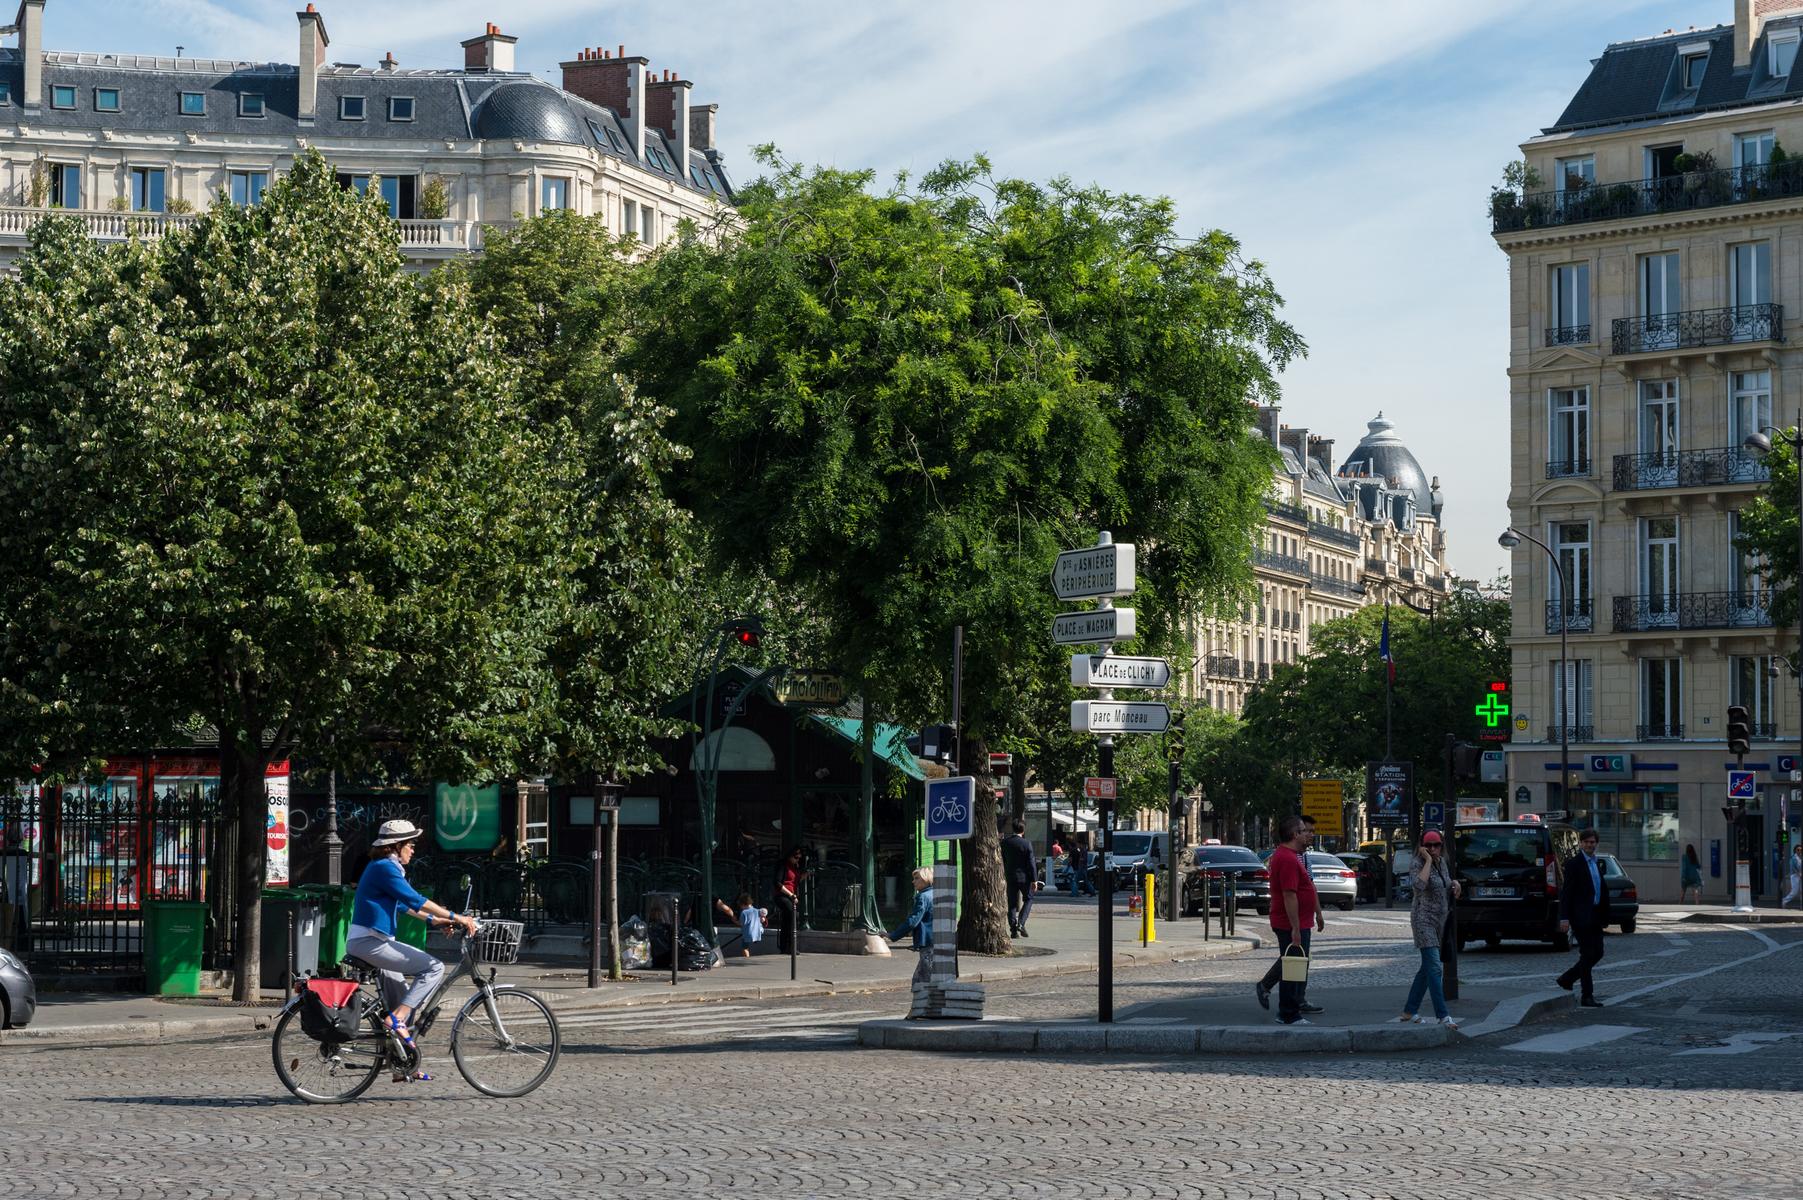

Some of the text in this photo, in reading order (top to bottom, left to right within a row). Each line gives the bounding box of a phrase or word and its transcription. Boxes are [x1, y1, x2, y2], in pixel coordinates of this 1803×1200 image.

[1057, 618, 1114, 636] PLACE DE WAGRAM
[1093, 664, 1156, 680] PLACE DE CLICHY
[1093, 709, 1148, 725] parc Monceau
[1594, 758, 1622, 770] CIC
[442, 791, 467, 826] M
[1430, 806, 1439, 820] P
